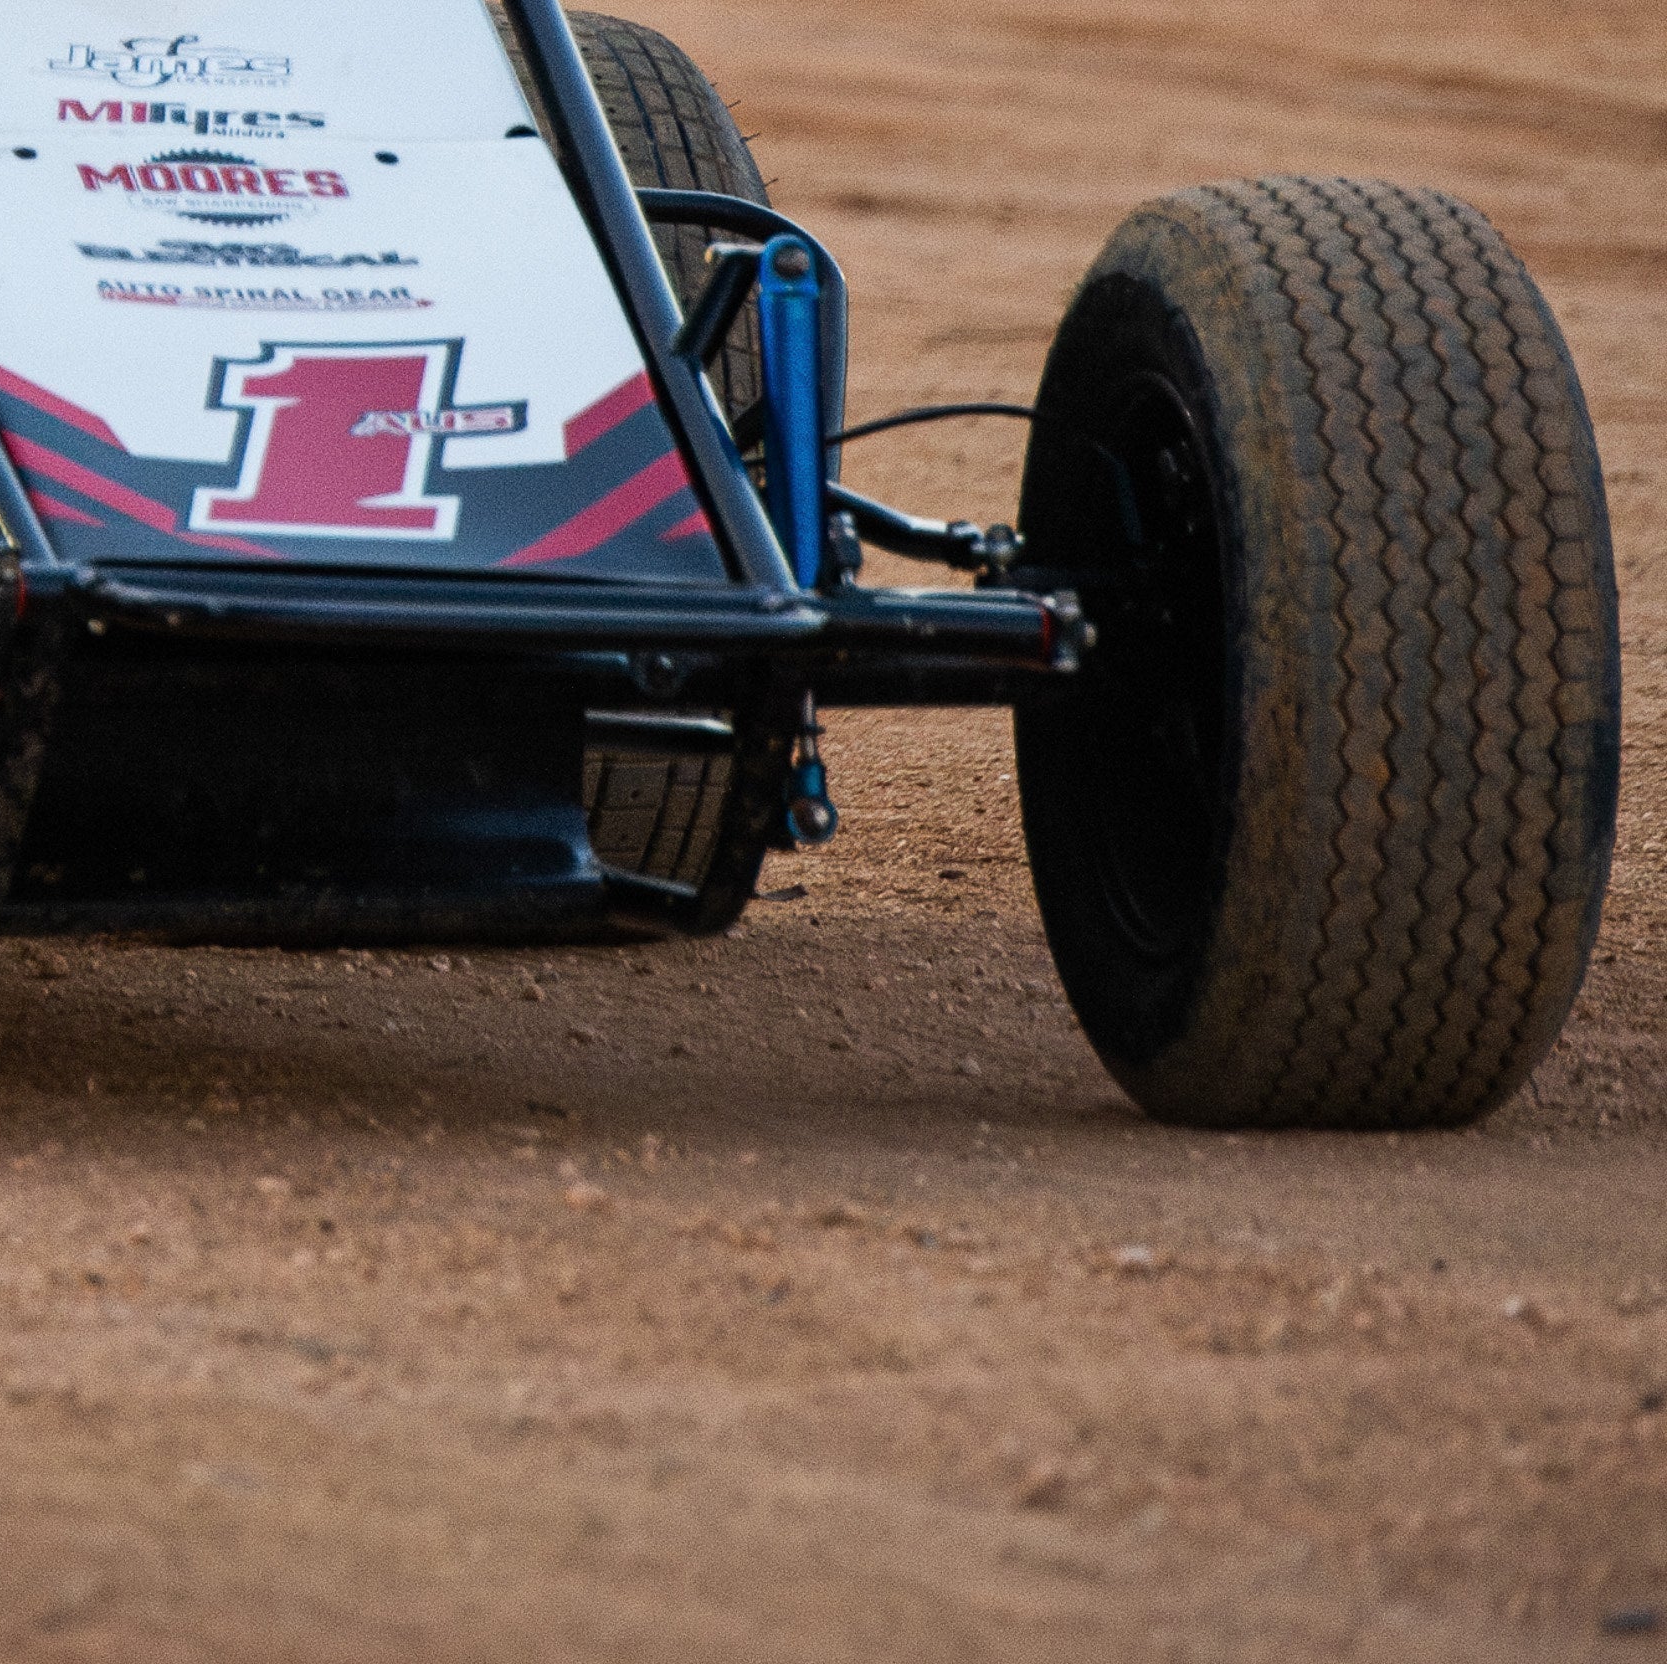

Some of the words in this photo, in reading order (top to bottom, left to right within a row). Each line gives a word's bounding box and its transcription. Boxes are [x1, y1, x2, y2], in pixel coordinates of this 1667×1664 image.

[75, 163, 351, 198] MOORES
[96, 278, 182, 296] AUTO
[193, 285, 305, 302] SPIRAL
[321, 284, 414, 302] GEAR
[191, 339, 460, 540] 1
